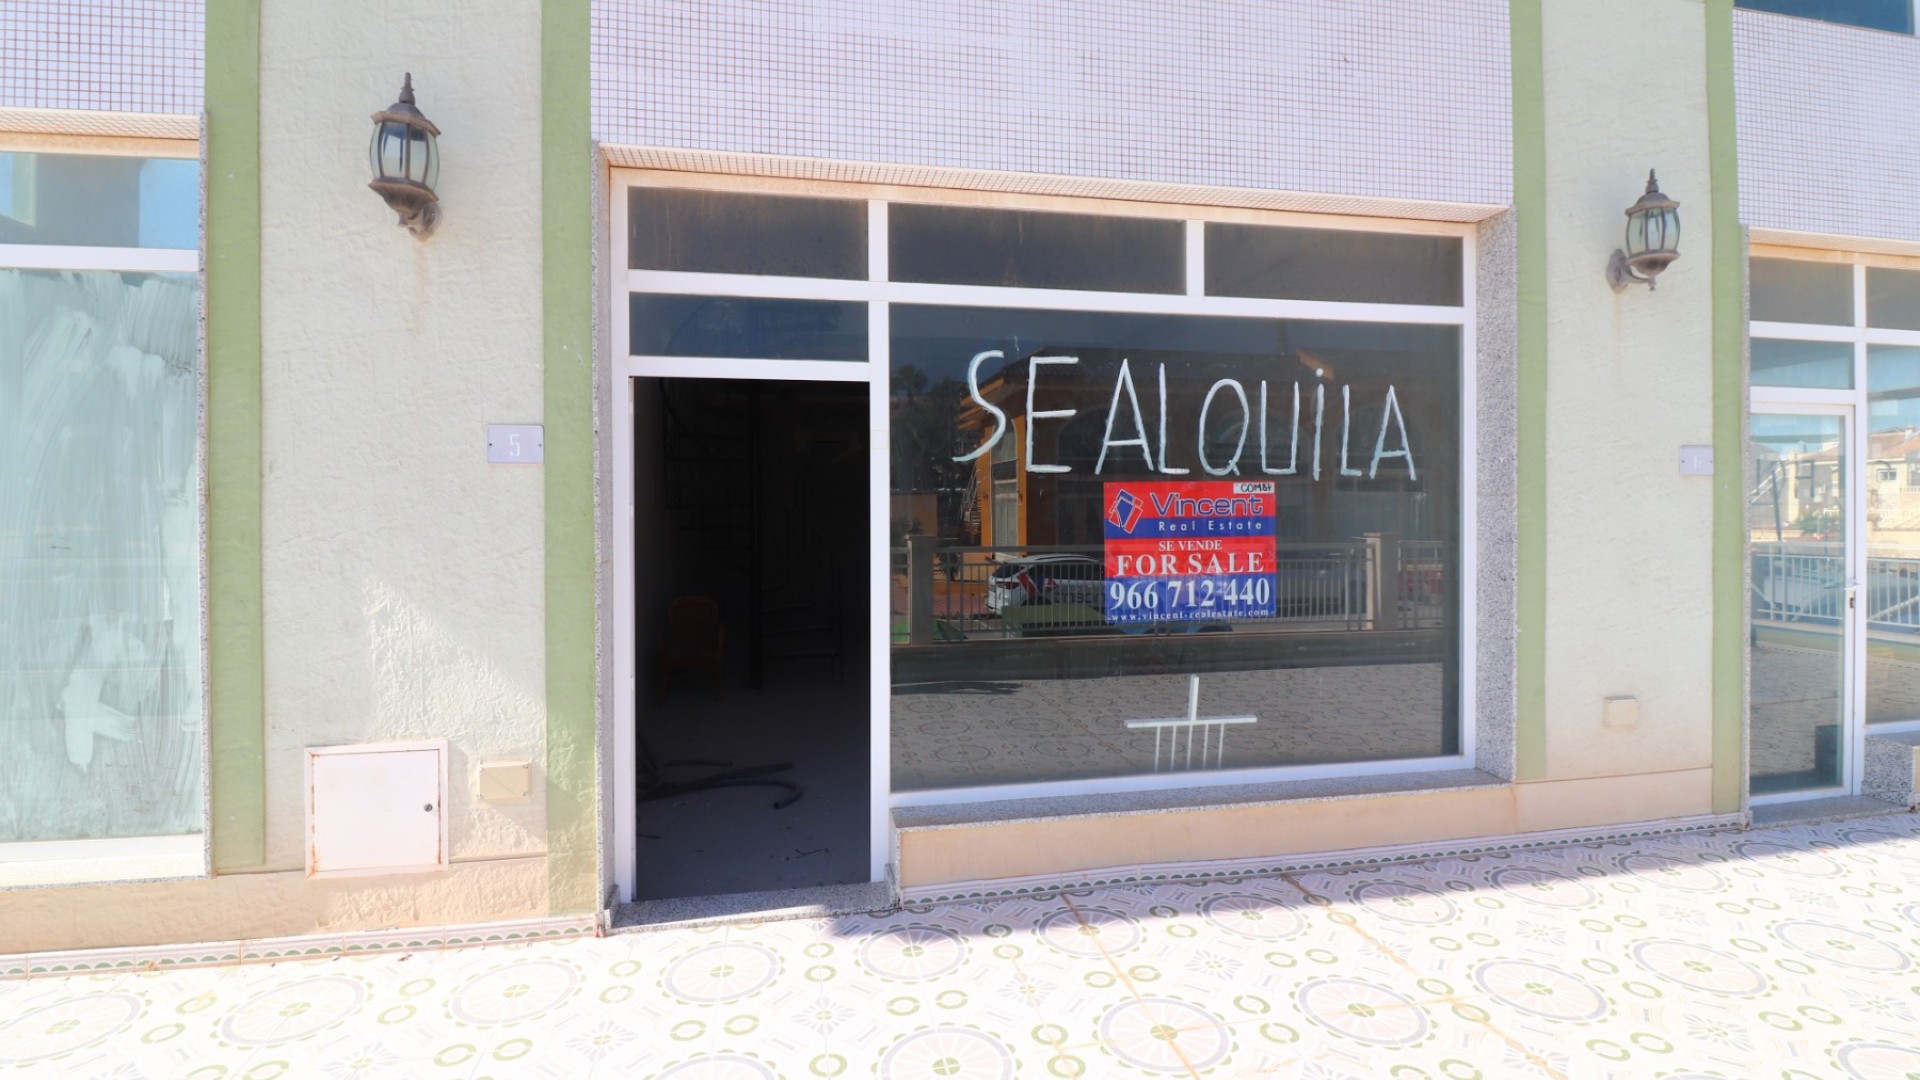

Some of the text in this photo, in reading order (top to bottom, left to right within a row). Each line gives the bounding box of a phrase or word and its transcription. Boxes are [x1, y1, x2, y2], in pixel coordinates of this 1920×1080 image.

[953, 351, 1078, 473] SE
[510, 433, 520, 457] 5
[1150, 492, 1264, 517] Vincent
[1159, 520, 1262, 531] Real Estate
[1159, 539, 1223, 551] SE VENDE
[1116, 552, 1265, 577] FOR SALE
[1109, 581, 1159, 611] 966
[1167, 579, 1215, 608] 712
[1224, 577, 1270, 606] 440
